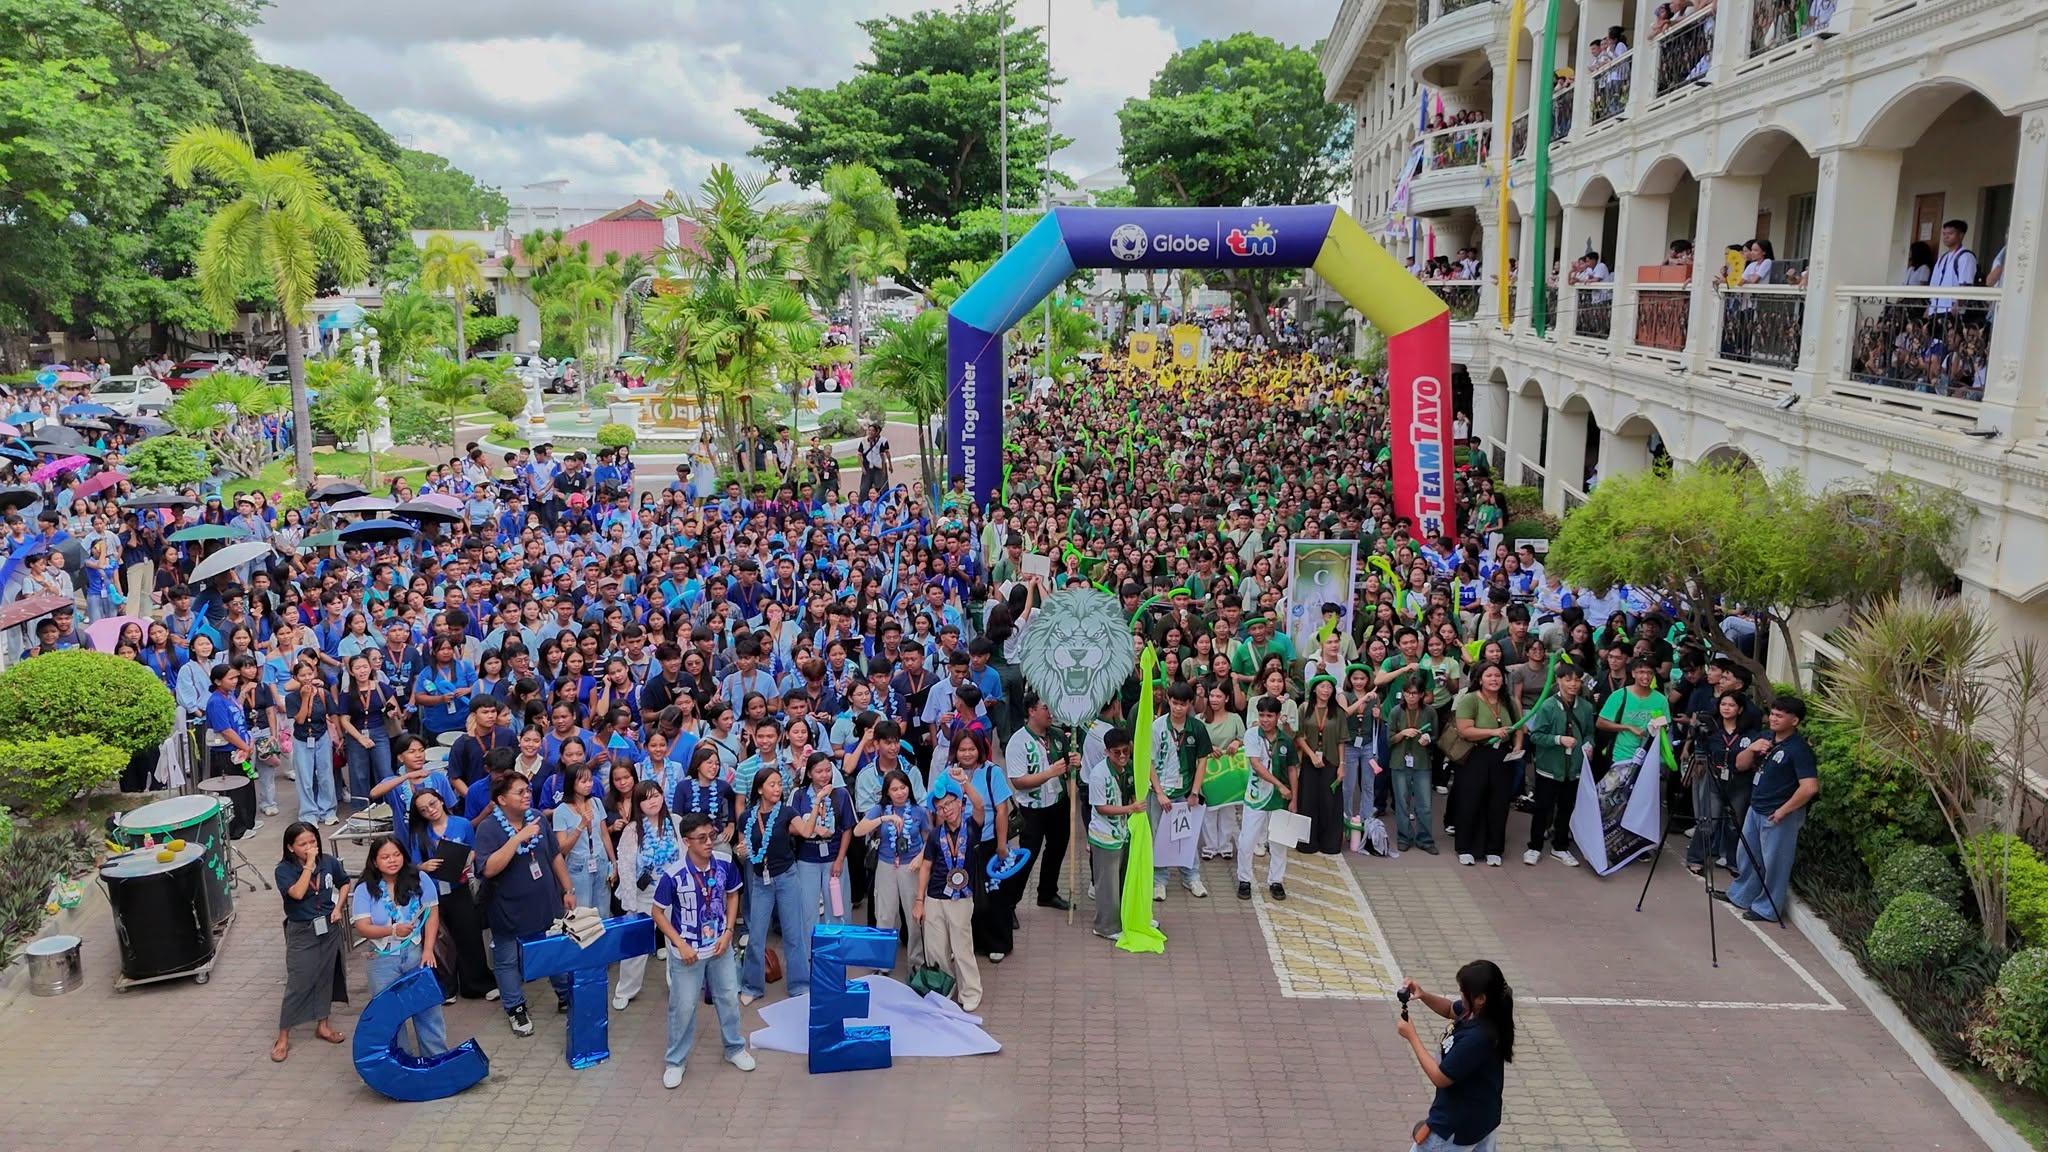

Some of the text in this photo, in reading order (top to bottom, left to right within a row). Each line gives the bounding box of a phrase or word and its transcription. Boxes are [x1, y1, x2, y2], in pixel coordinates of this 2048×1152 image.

[1153, 233, 1210, 252] Globe
[1227, 229, 1277, 256] tm
[961, 361, 979, 501] rward Together
[1413, 379, 1442, 532] #TEAMTAYO
[1172, 816, 1190, 833] 1A
[675, 873, 699, 949] TESC
